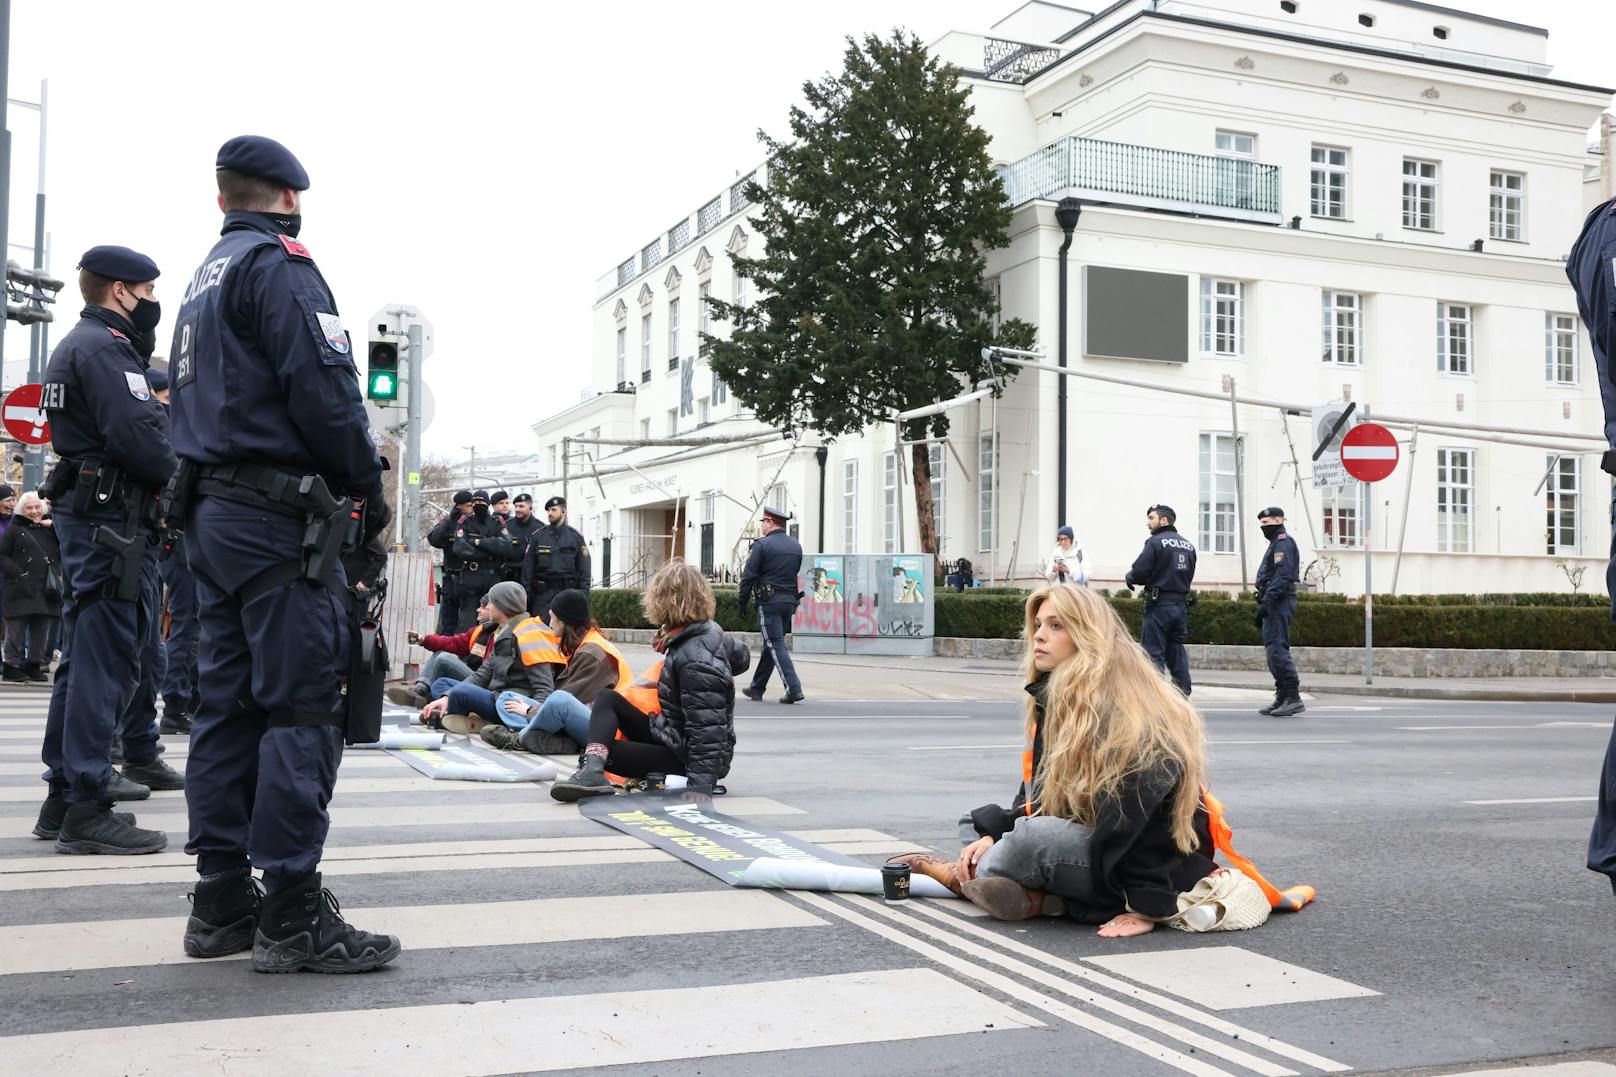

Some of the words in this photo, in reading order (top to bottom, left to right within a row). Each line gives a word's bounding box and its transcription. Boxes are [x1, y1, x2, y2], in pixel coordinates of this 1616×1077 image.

[181, 256, 232, 306] OLIZEI
[181, 323, 191, 354] D
[178, 355, 190, 381] 251
[43, 383, 65, 409] ZEI
[1161, 538, 1193, 551] POLIZEI
[1178, 554, 1186, 563] D
